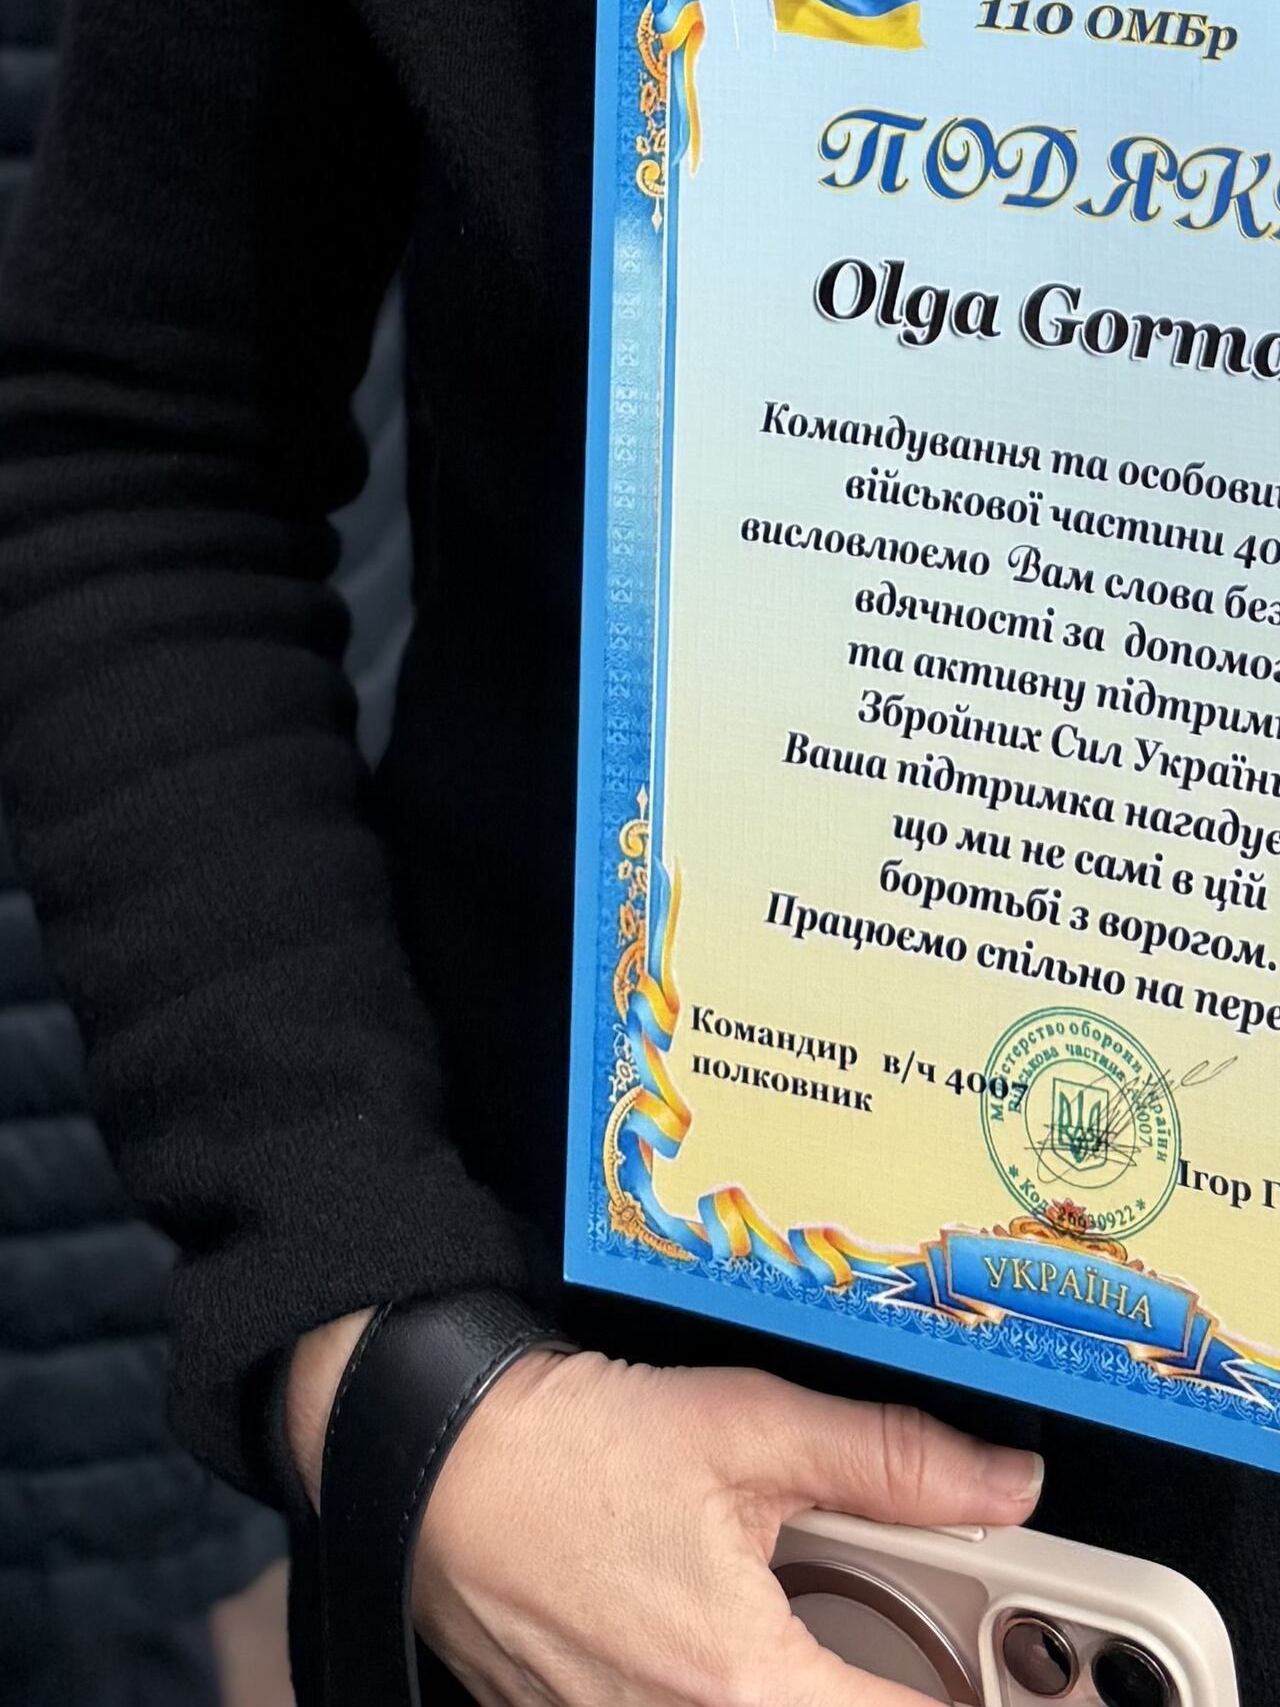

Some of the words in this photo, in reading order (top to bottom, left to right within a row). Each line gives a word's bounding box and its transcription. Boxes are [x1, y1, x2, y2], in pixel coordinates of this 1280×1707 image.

[1084, 3, 1239, 60] ОМБр
[815, 257, 1001, 346] Olga
[761, 402, 1041, 471] Командування
[1052, 450, 1109, 482] та
[845, 466, 1044, 527] військової
[1050, 506, 1224, 557] частини
[741, 518, 990, 576] висловлюємо
[1007, 545, 1094, 594] Вам
[1104, 574, 1214, 615] слова
[855, 580, 1055, 643] вдячності
[1062, 623, 1105, 652] за
[848, 642, 904, 673] та
[913, 654, 1086, 712] активну
[858, 690, 1042, 753] Збройних
[1051, 724, 1122, 768] Сил
[784, 732, 887, 780] Ваша
[897, 753, 1115, 823] підтримка
[893, 815, 948, 852] що
[955, 828, 1011, 860] ми
[1022, 839, 1066, 870] не
[1074, 851, 1163, 890] самі
[1172, 870, 1194, 895] в
[1204, 868, 1267, 912] цій
[766, 892, 967, 962] Працюємо
[977, 940, 1126, 995] спільно
[1136, 976, 1184, 1009] на
[880, 859, 1062, 926] боротьбі
[1069, 906, 1089, 931] з
[1099, 912, 1276, 972] ворогом.
[691, 1004, 858, 1071] Командир
[883, 1049, 936, 1084] в/ч
[944, 1067, 1029, 1108] 4007
[691, 1053, 874, 1113] полковник
[991, 1022, 1065, 1122] Мстерство
[1069, 1020, 1143, 1074] оборони
[1065, 1043, 1126, 1083] частина
[1177, 1158, 1252, 1209] Ігор
[983, 1255, 1153, 1328] УКРАЇНА
